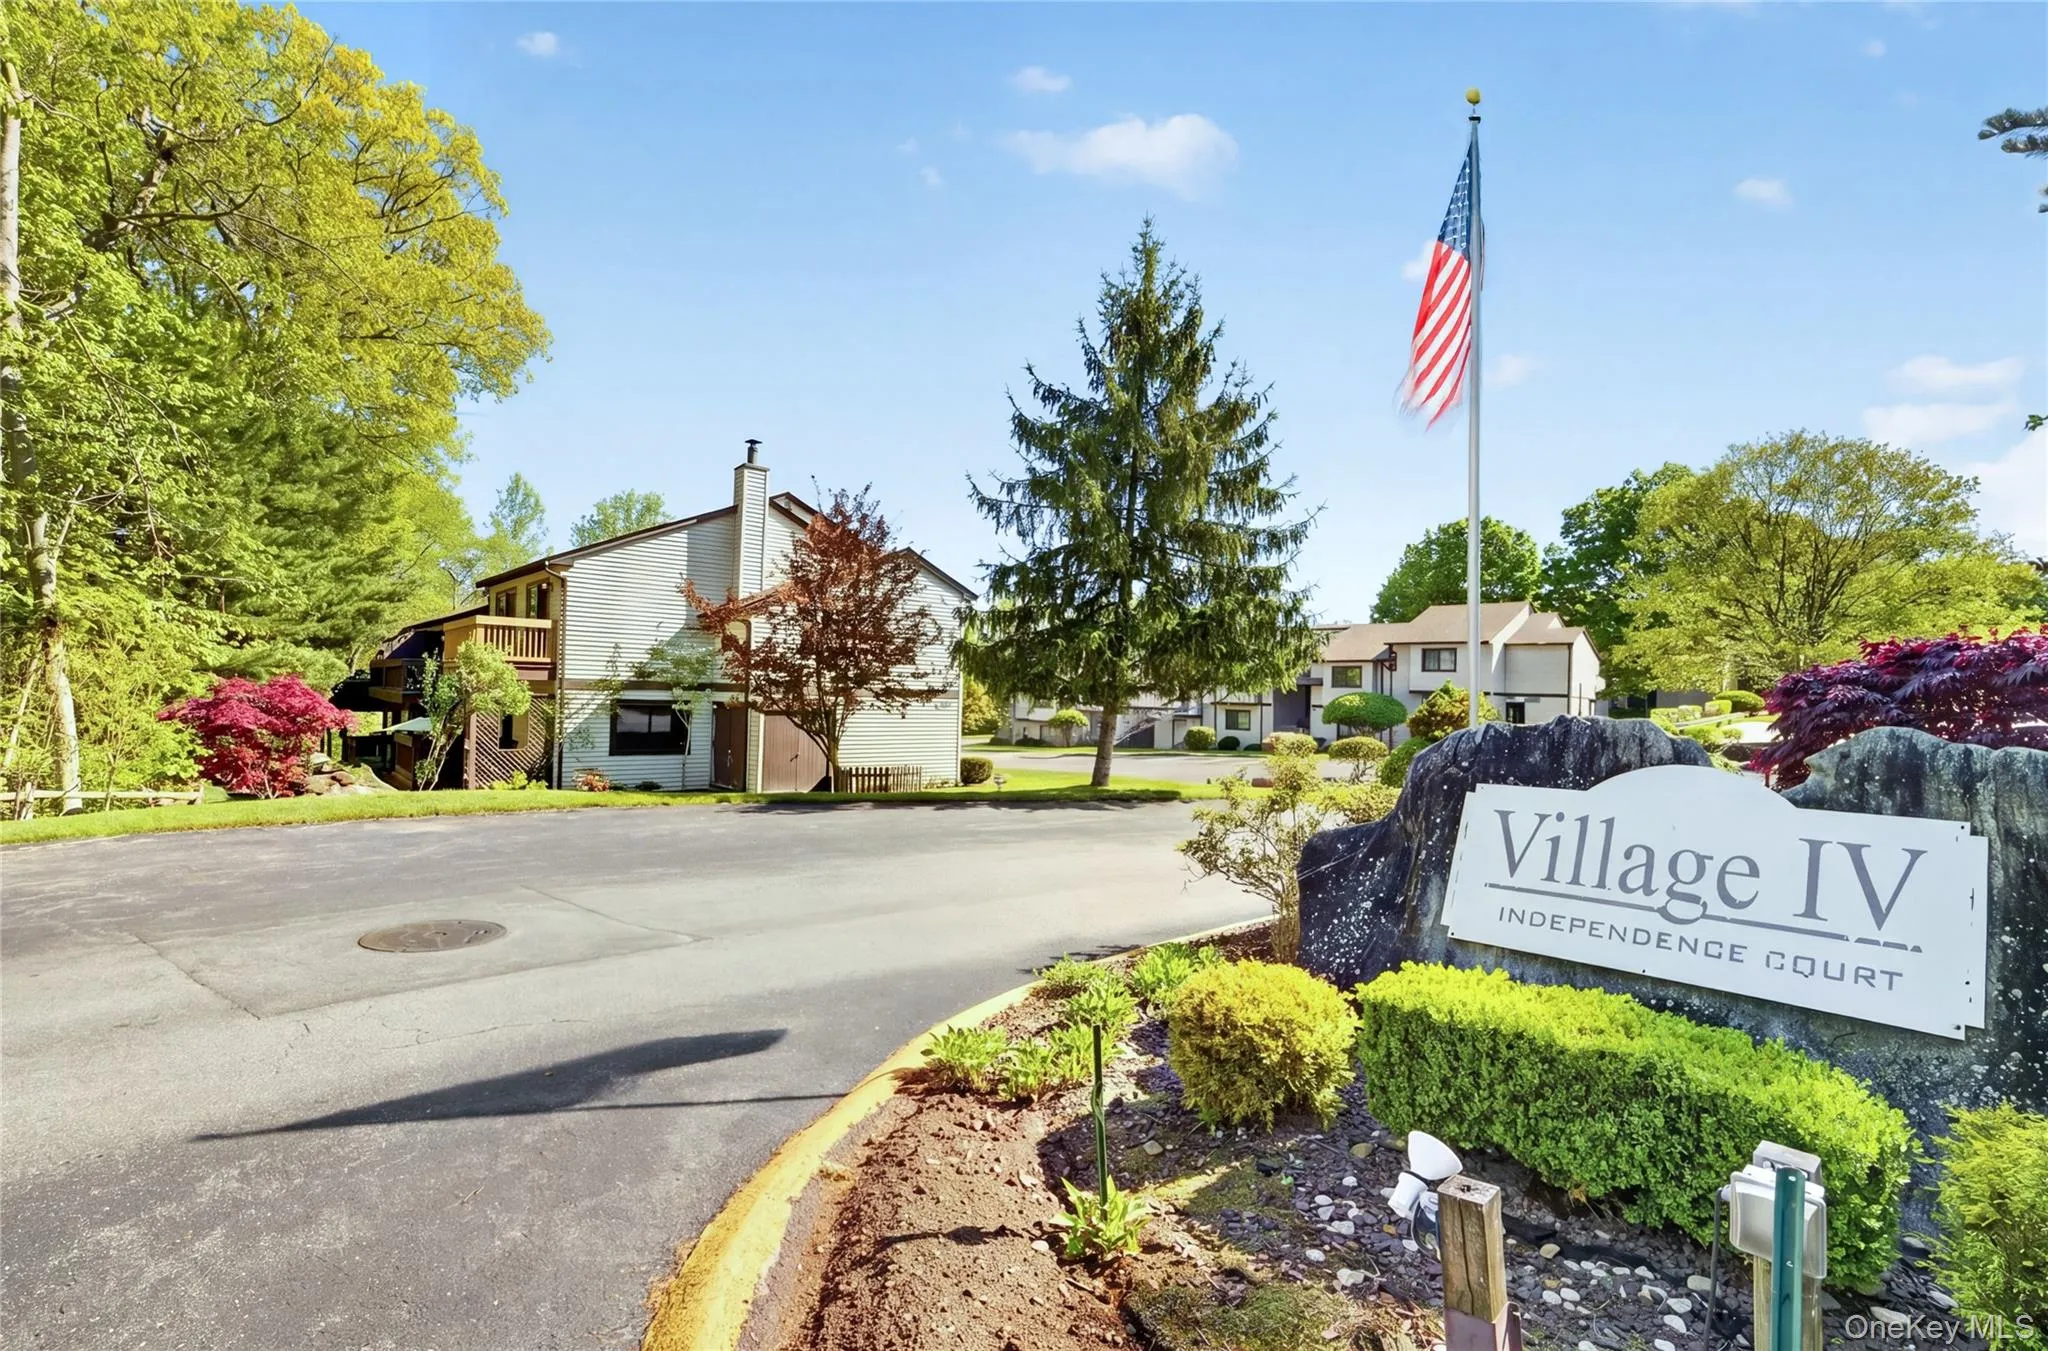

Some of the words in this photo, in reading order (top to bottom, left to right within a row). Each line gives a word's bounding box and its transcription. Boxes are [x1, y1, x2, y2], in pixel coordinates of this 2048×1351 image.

[1493, 809, 1760, 925] Village
[1792, 836, 1928, 931] IV
[1499, 906, 1748, 964] INDEPENDENCE
[1765, 949, 1904, 992] COURT
